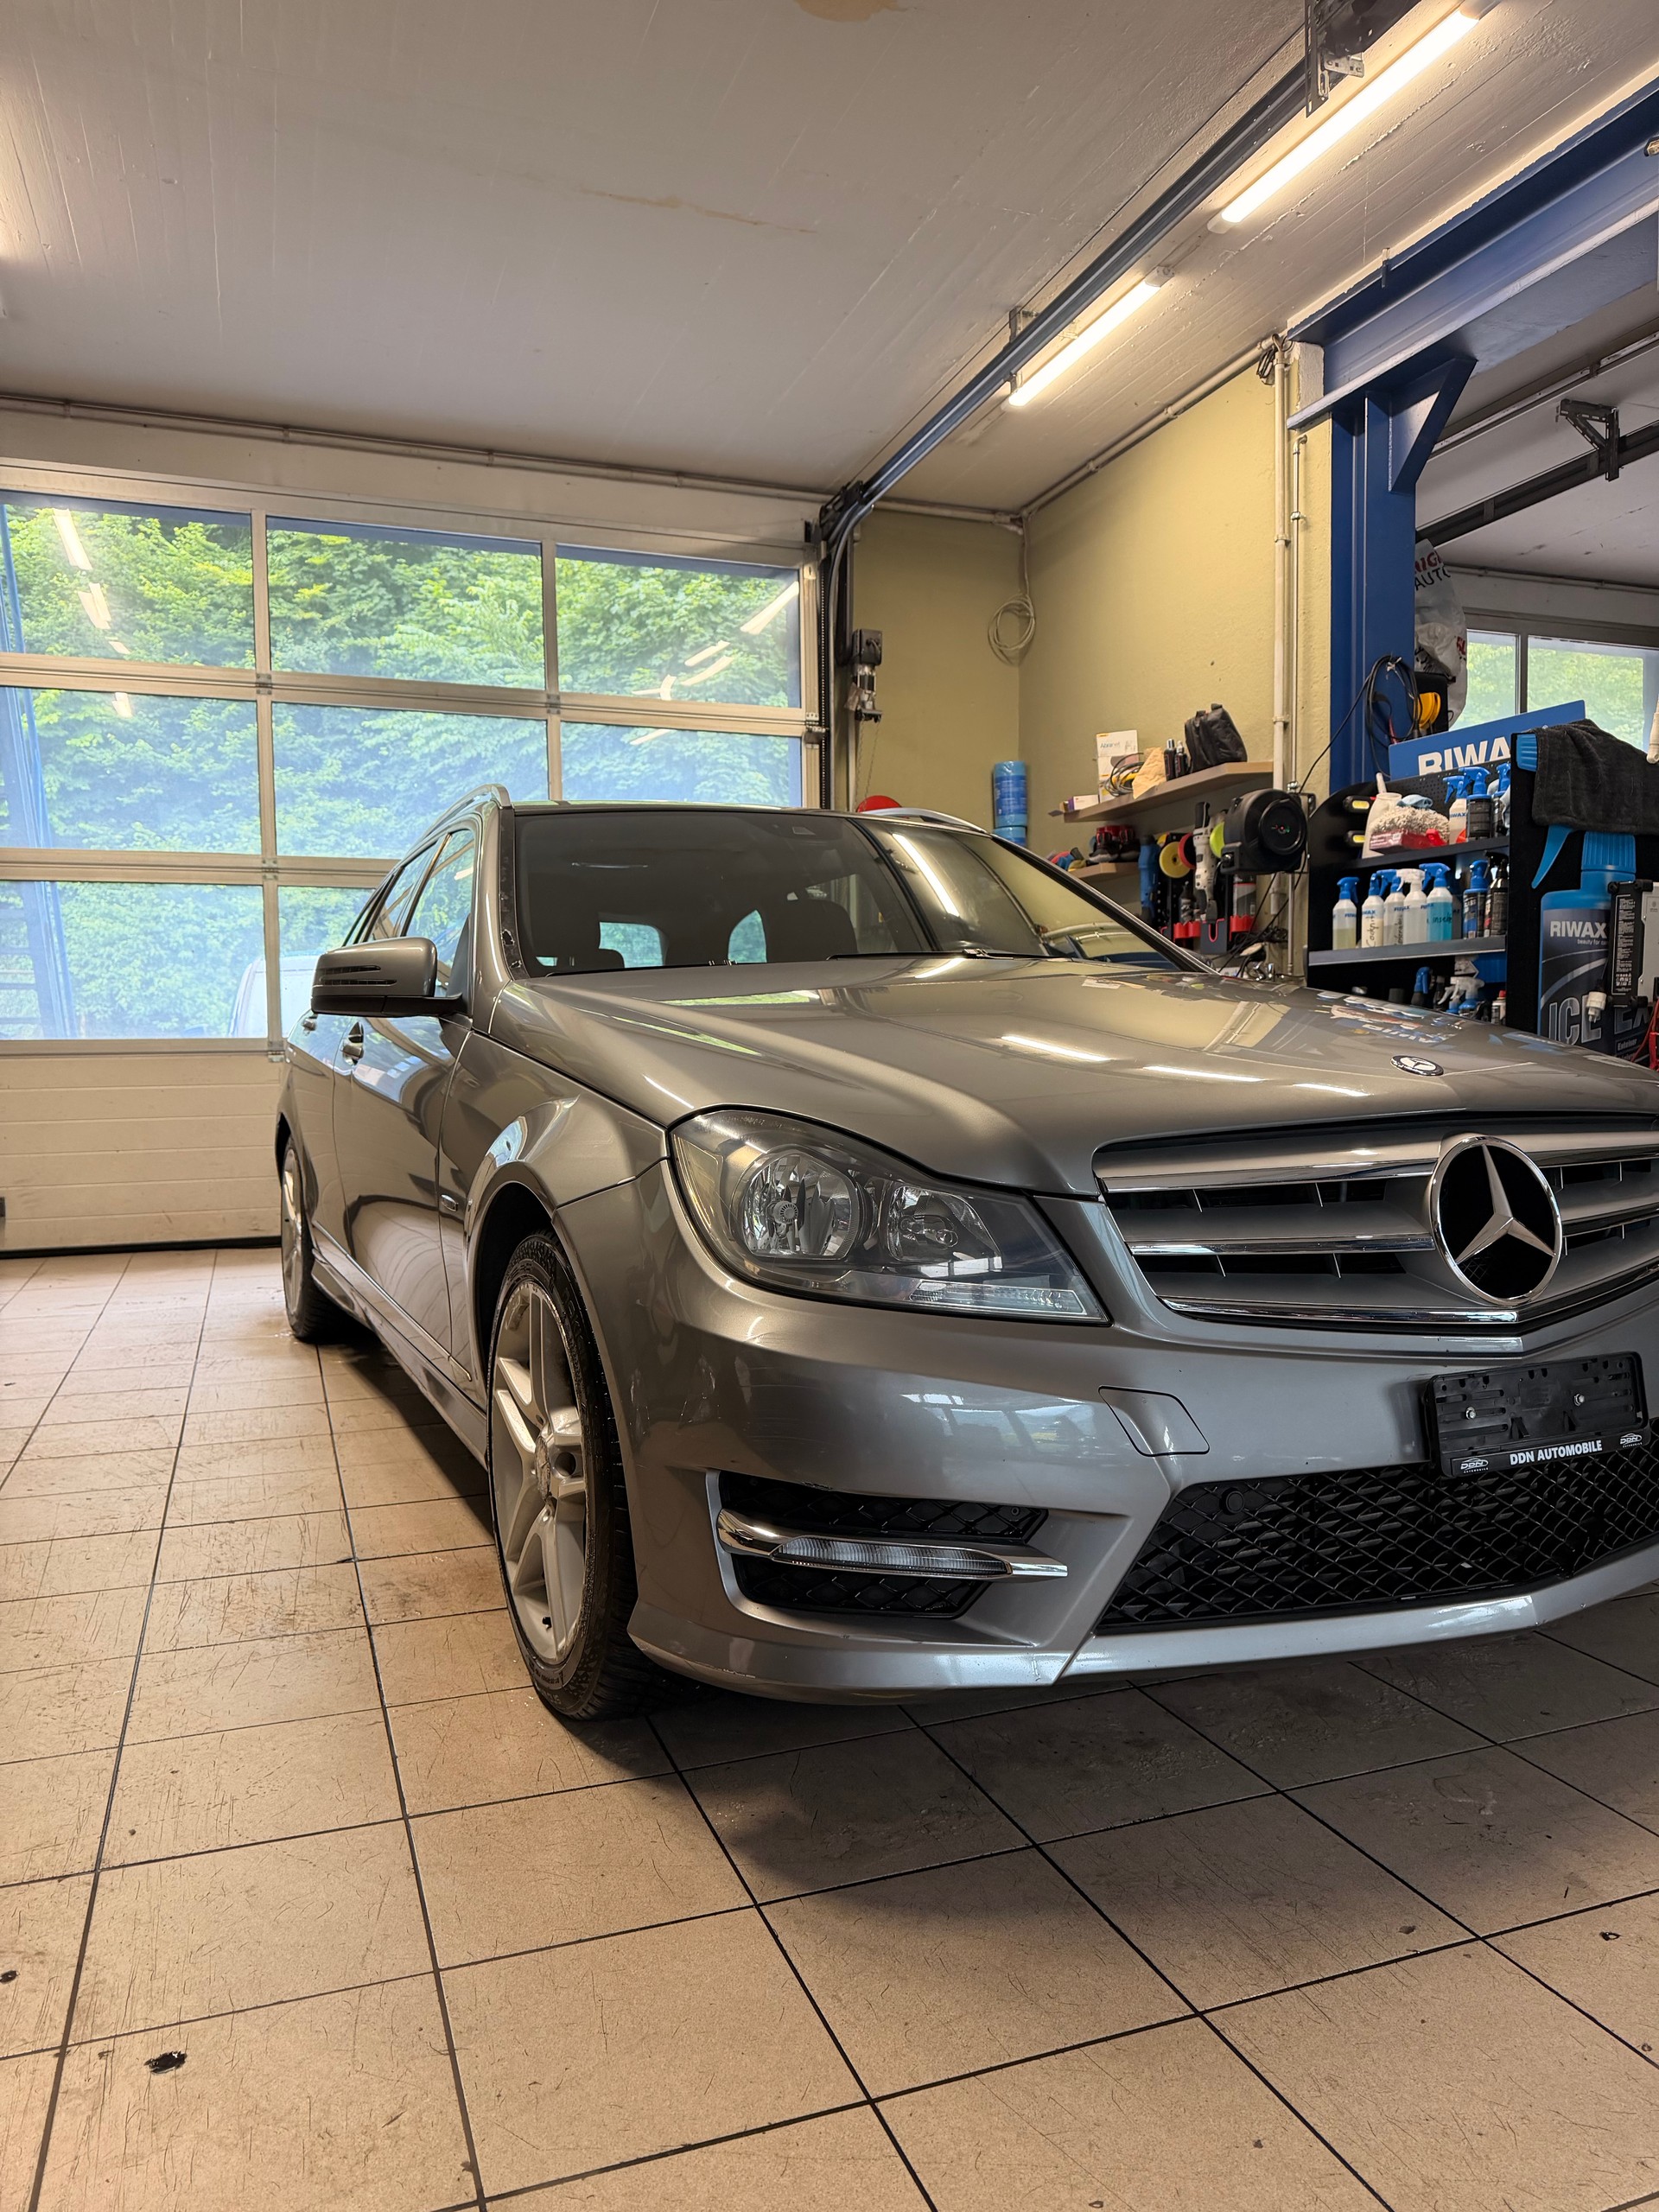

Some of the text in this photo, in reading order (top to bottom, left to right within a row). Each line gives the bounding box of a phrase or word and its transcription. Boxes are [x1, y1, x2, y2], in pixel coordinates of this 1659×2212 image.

[1418, 736, 1511, 776] RIWA
[1550, 920, 1607, 939] RIWAX
[1549, 995, 1602, 1044] ICE
[1510, 1440, 1603, 1465] DDN AUTOMOBILE
